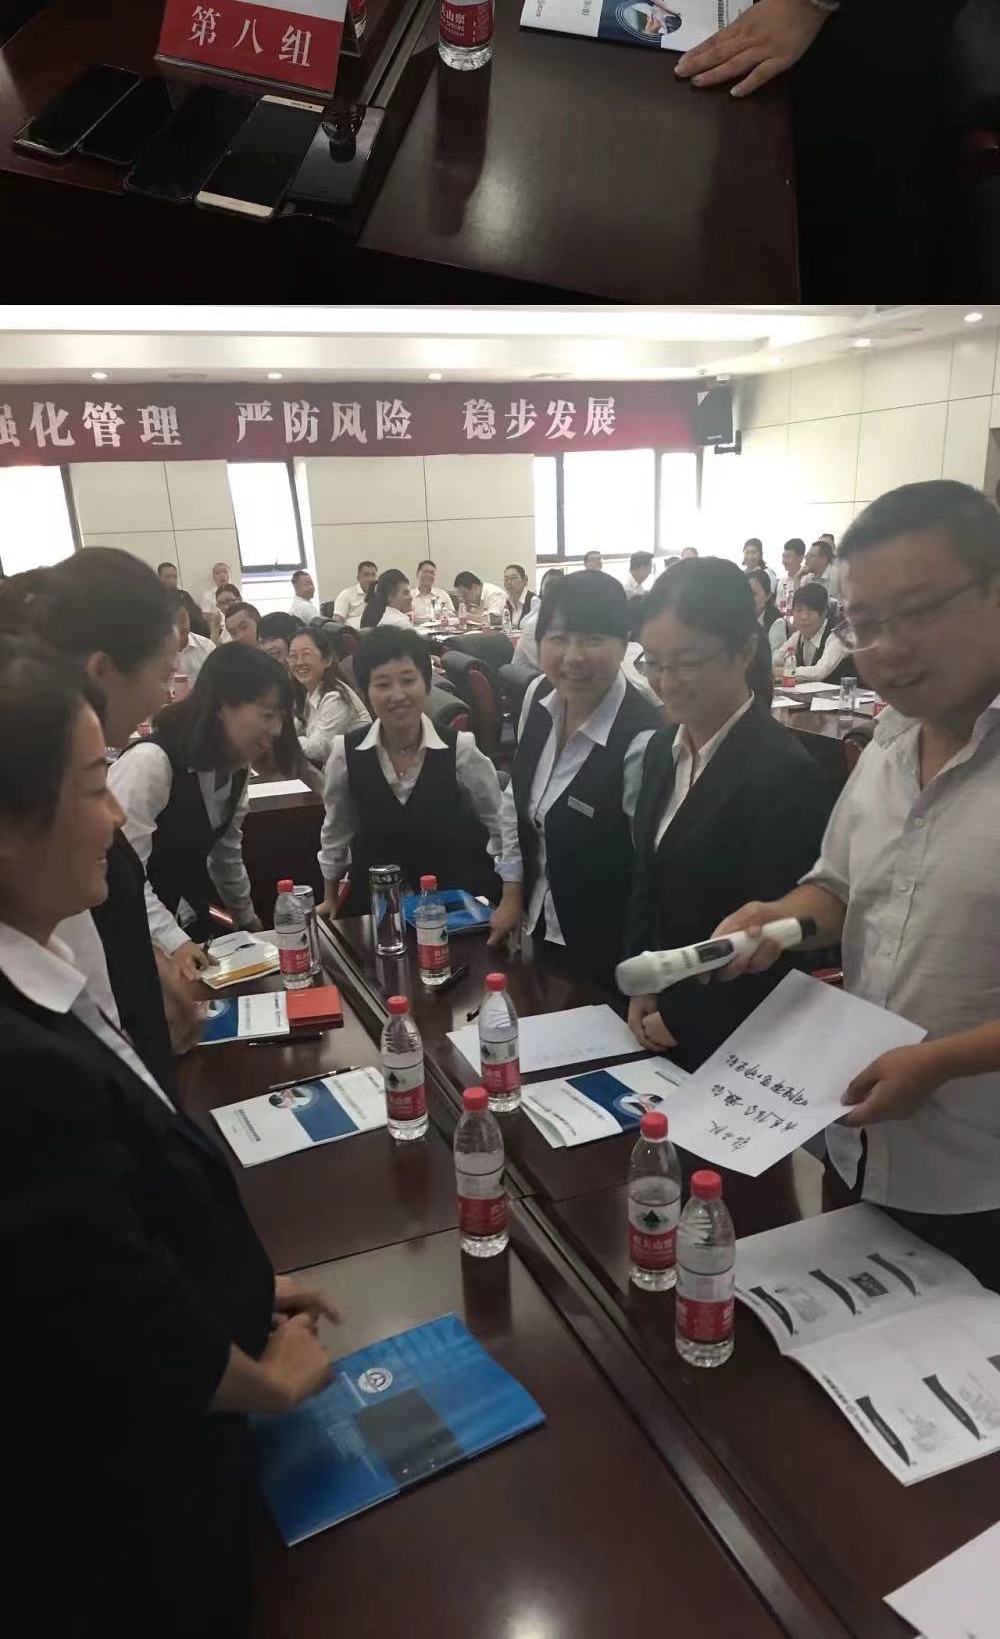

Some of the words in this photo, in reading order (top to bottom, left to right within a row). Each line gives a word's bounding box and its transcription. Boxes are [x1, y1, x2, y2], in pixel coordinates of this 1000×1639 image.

[187, 5, 312, 67] 第八组
[235, 399, 412, 443] 严防风险
[462, 396, 616, 440] 稳步发展
